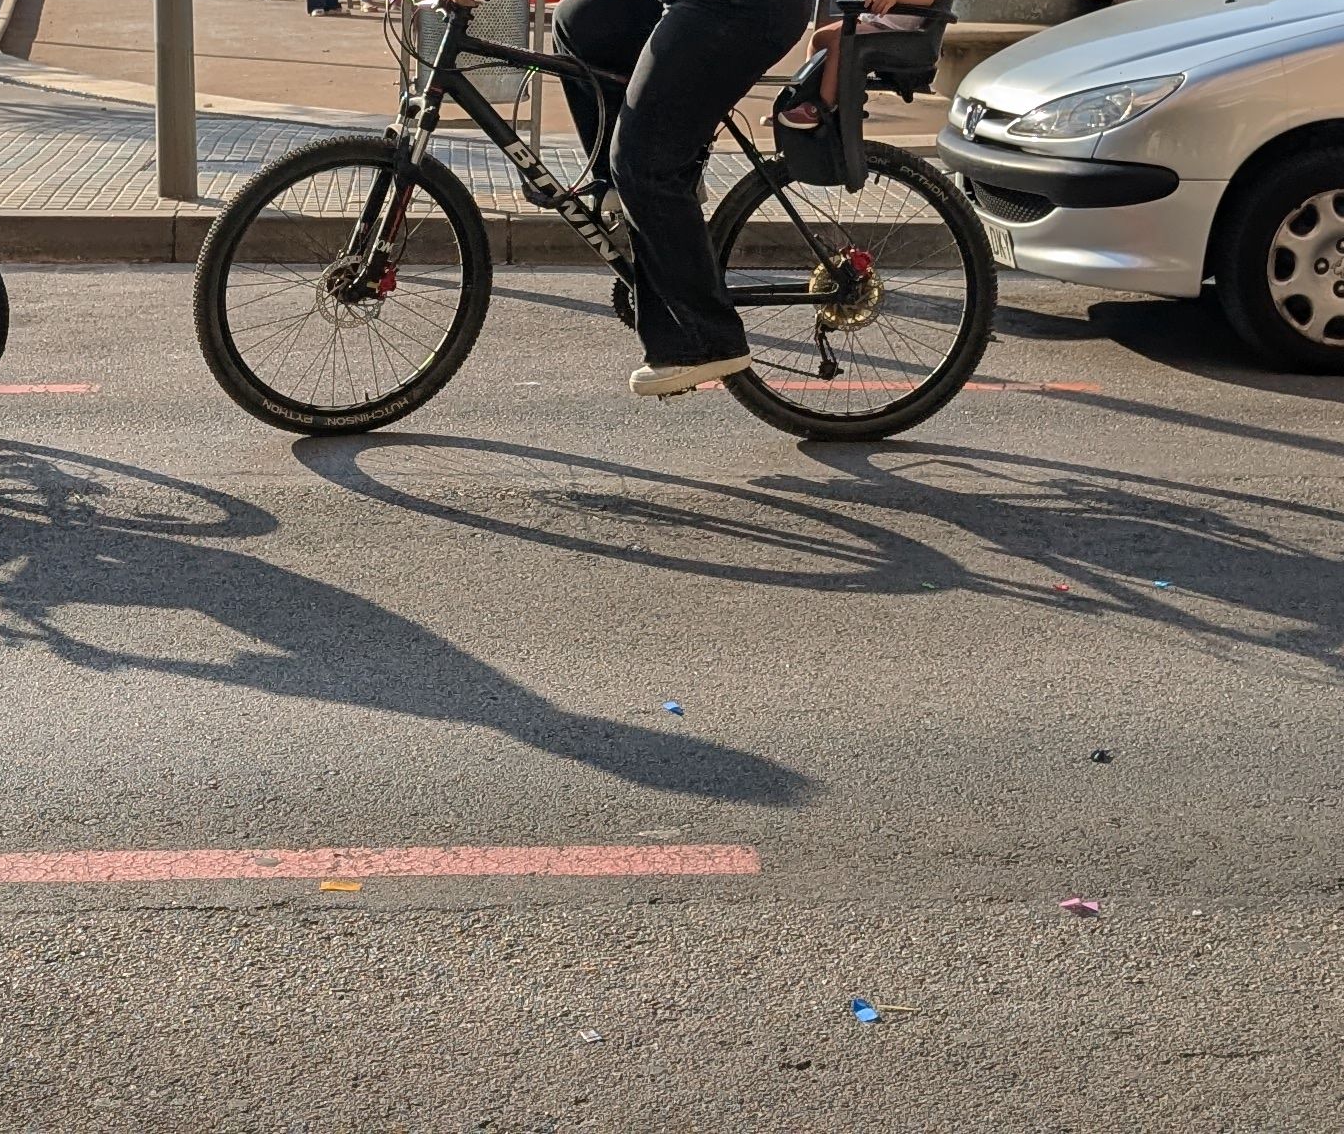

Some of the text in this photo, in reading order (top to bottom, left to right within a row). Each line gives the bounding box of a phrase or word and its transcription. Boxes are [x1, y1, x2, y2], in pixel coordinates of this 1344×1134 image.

[899, 166, 949, 202] PYTHON
[262, 396, 409, 426] HUTCHINSON PYTHON
